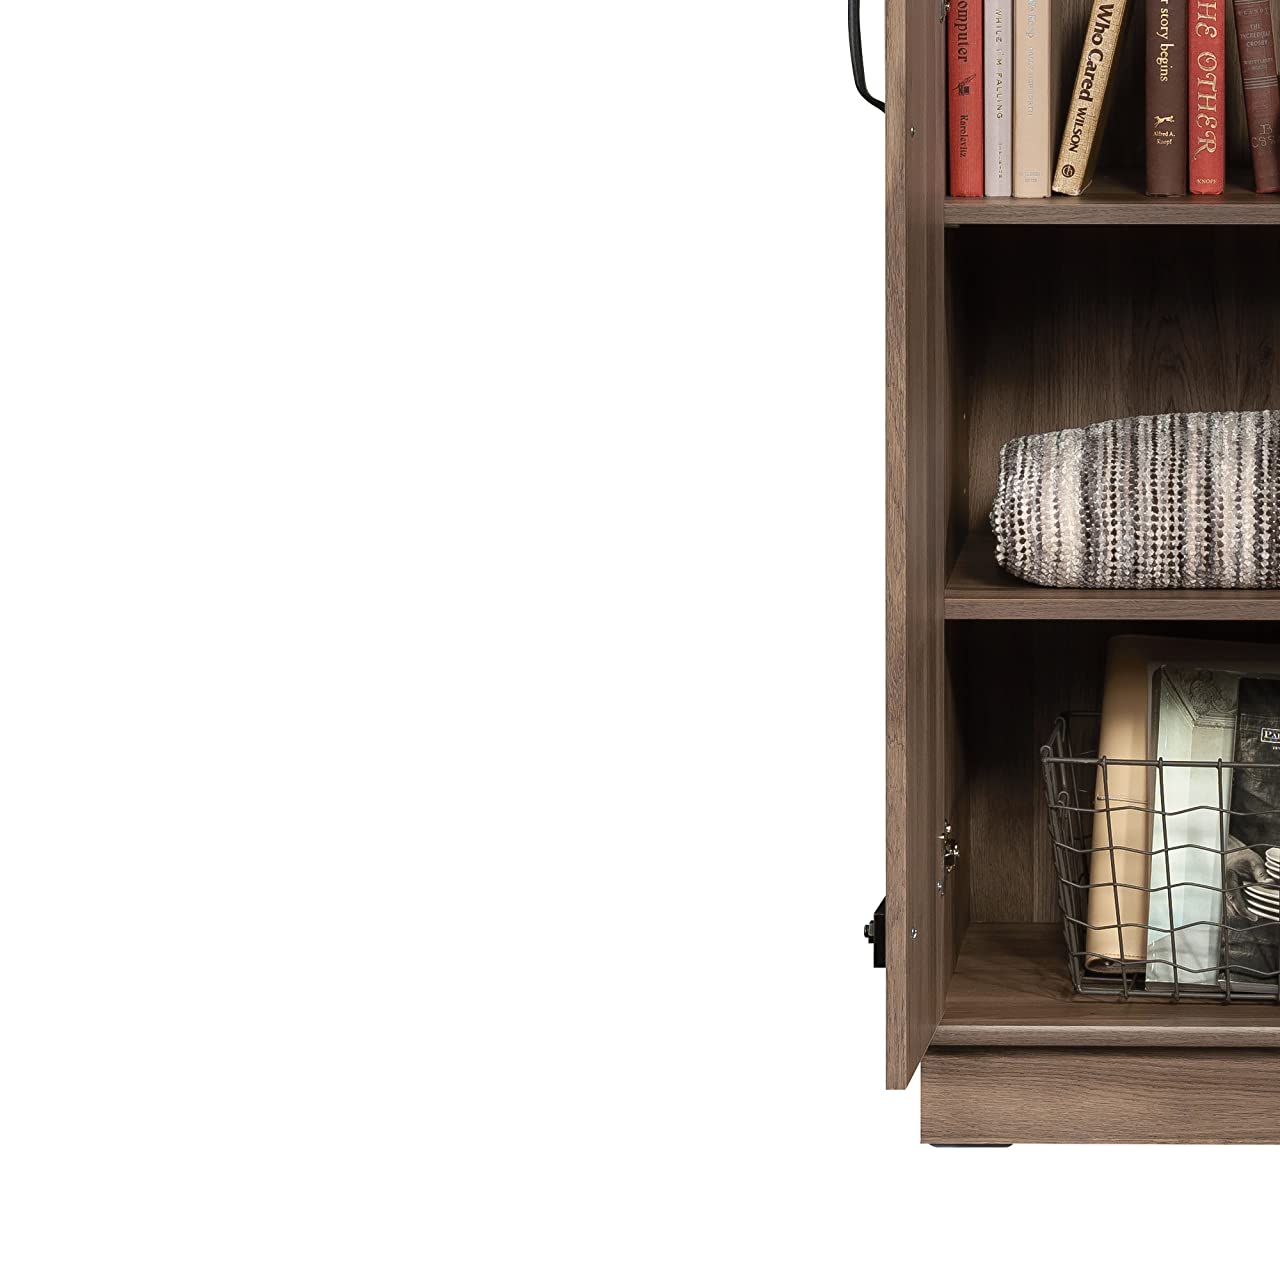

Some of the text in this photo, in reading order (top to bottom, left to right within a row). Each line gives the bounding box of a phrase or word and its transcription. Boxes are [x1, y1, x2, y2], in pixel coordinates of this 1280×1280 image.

[1091, 3, 1115, 46] Who
[1156, 7, 1169, 40] story
[1078, 48, 1104, 103] Cared
[1156, 43, 1175, 82] begins
[1193, 51, 1218, 160] OTHER
[1068, 107, 1088, 153] WILSON
